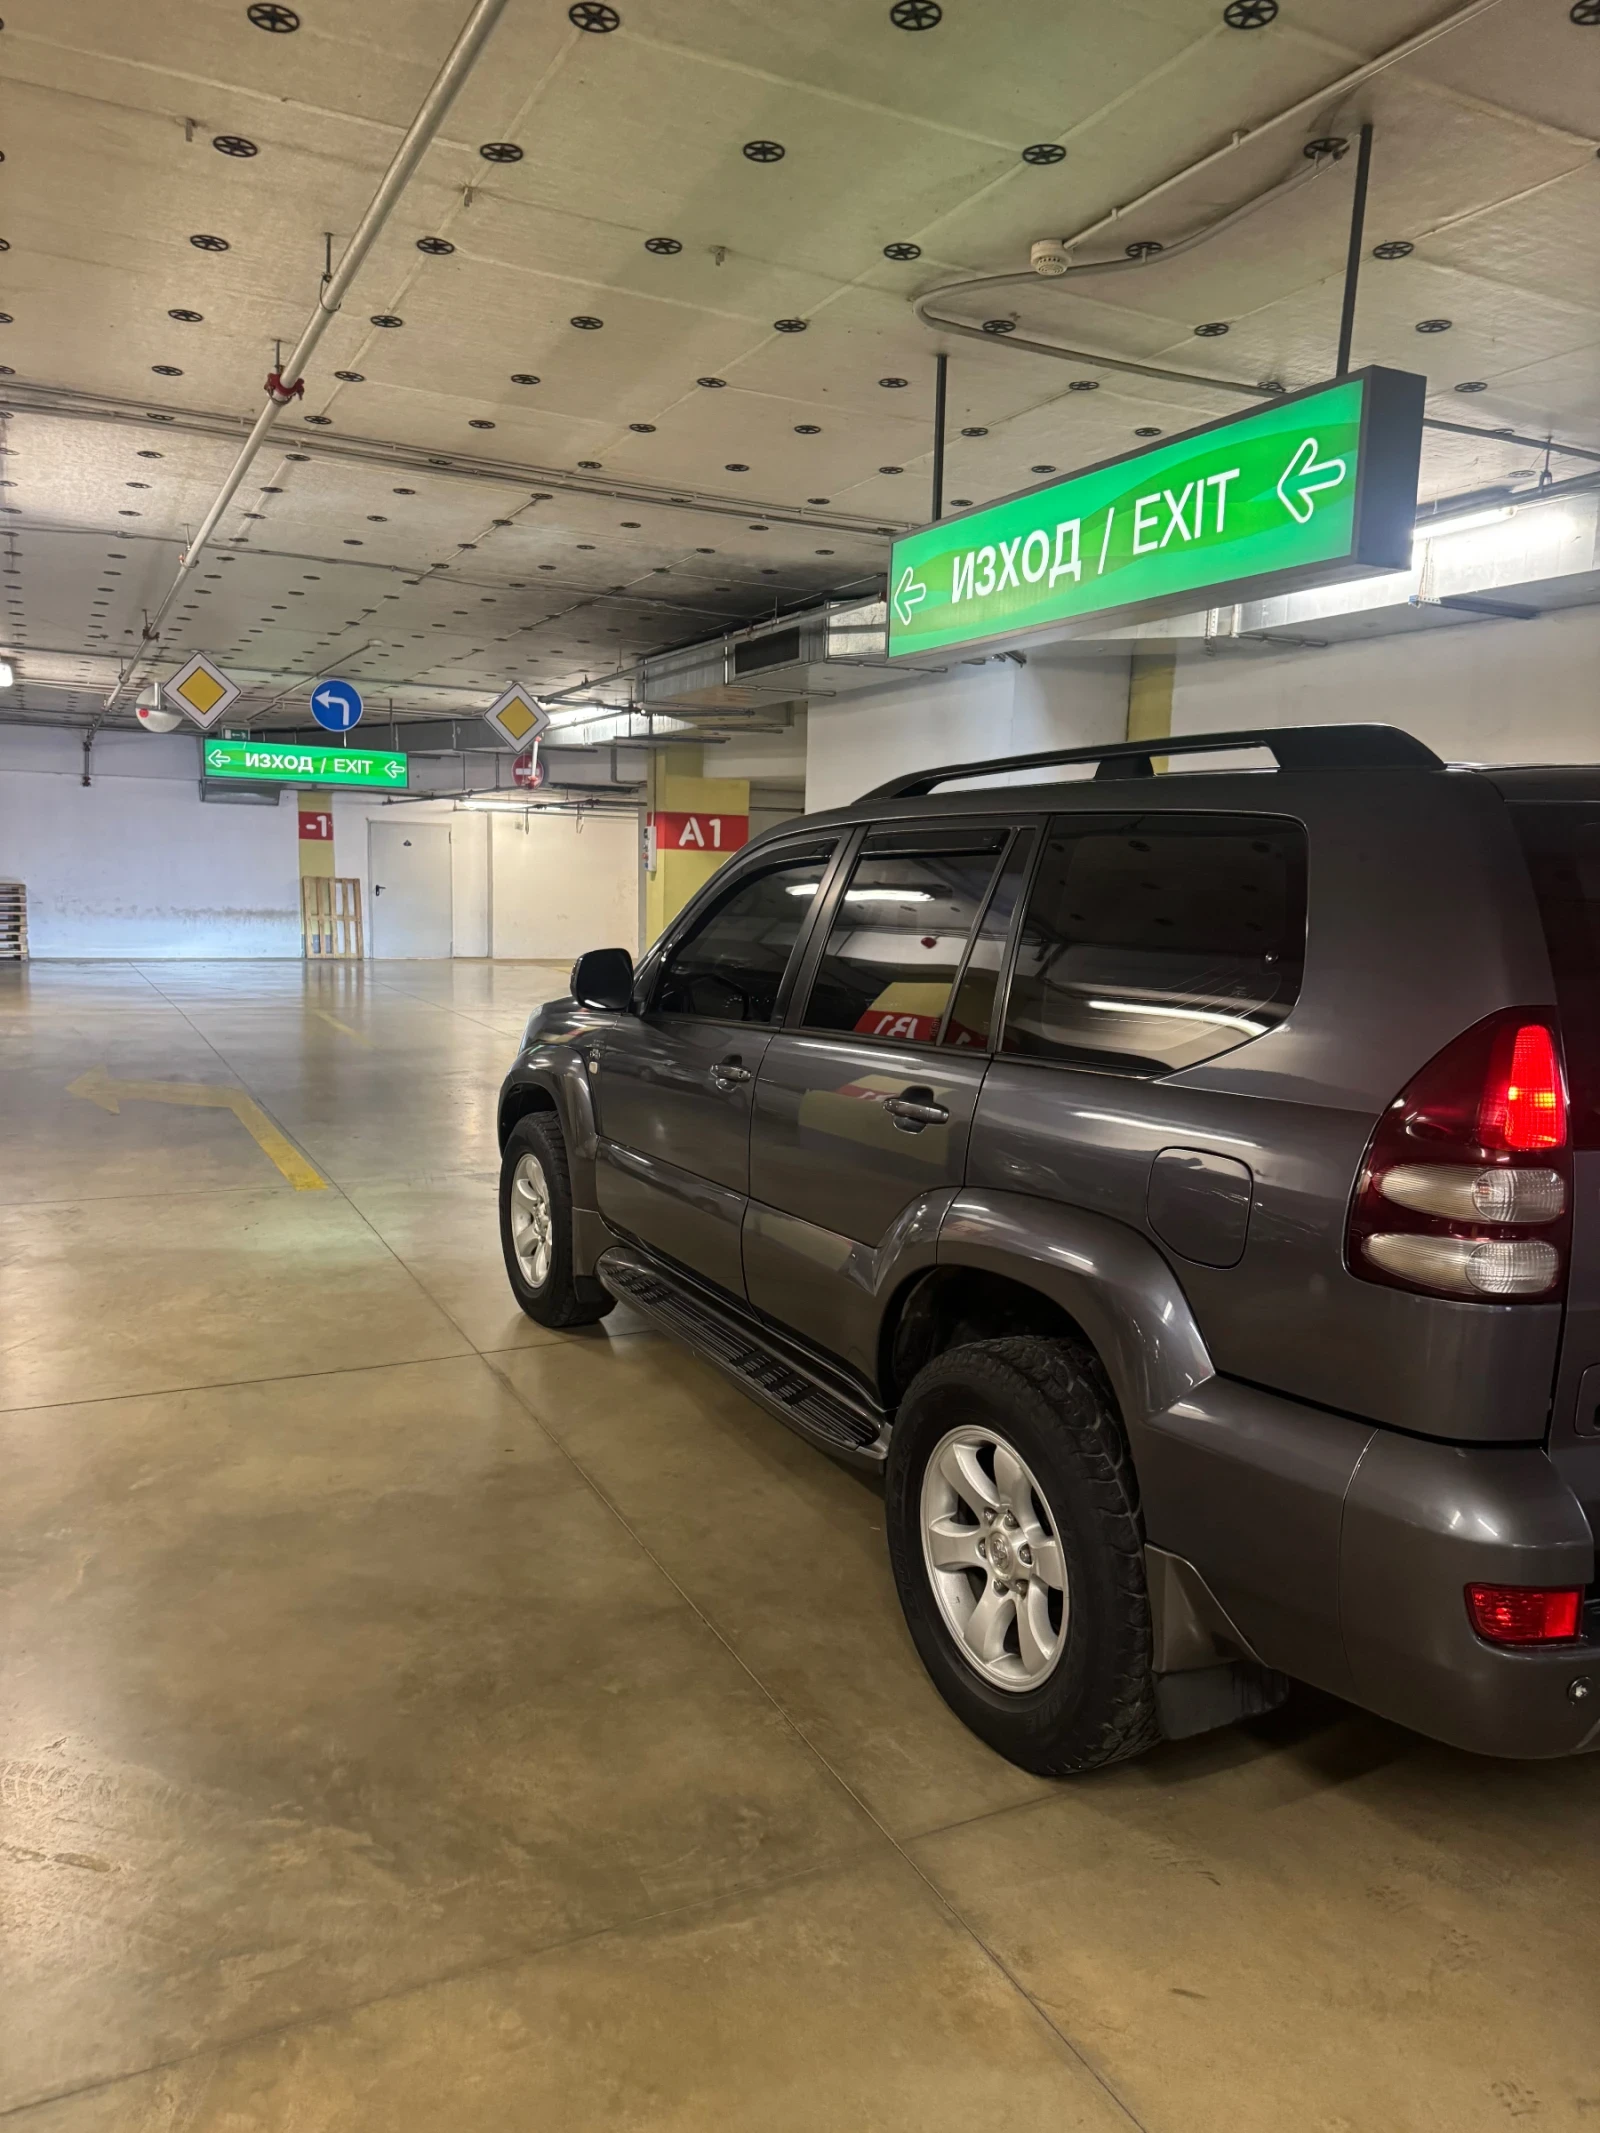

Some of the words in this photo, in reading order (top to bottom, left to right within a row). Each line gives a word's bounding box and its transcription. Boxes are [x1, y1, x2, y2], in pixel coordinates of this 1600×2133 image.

[951, 517, 1082, 603] ИЗХОД
[1097, 508, 1114, 575] /
[1132, 468, 1240, 556] EXIT
[245, 753, 313, 773] ИЗХОД
[320, 758, 326, 774] /
[334, 758, 373, 775] EXIT
[305, 815, 327, 837] -1
[678, 816, 721, 848] A1
